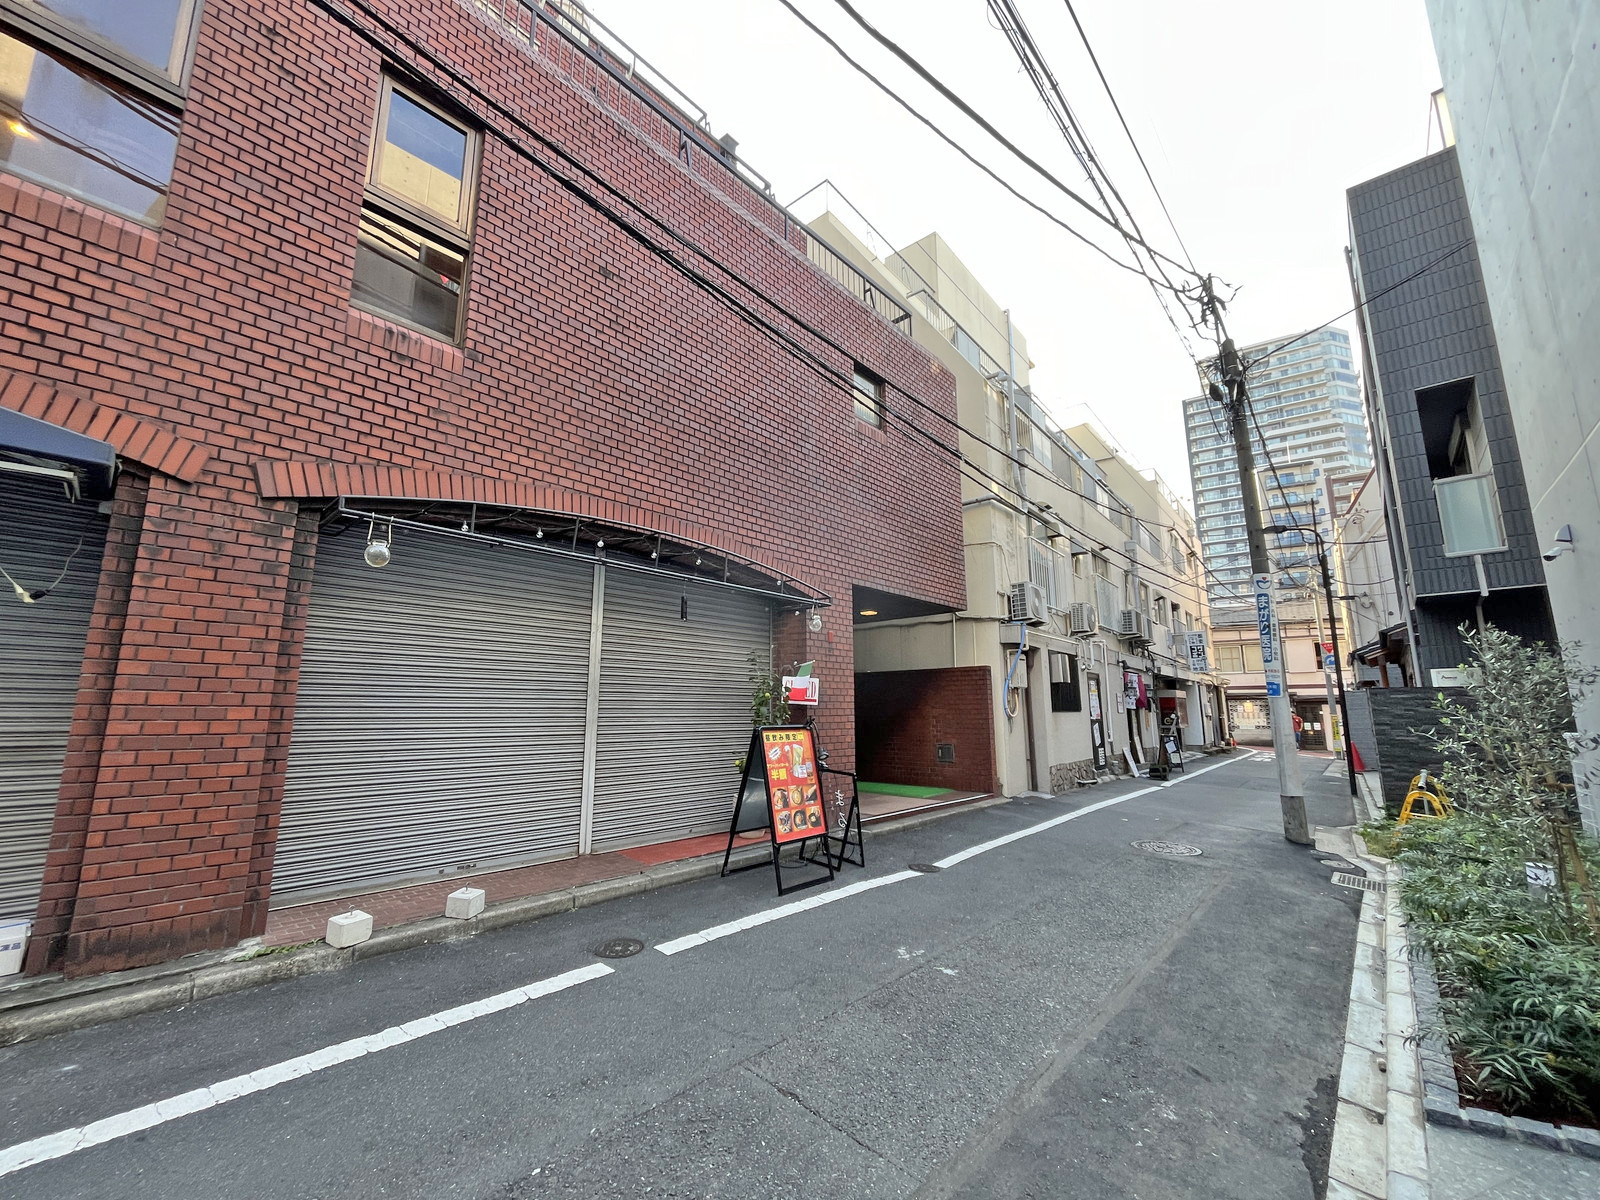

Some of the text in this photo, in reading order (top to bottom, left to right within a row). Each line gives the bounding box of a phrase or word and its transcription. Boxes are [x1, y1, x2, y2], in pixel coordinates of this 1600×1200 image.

[1258, 595, 1272, 661] まがり医院
